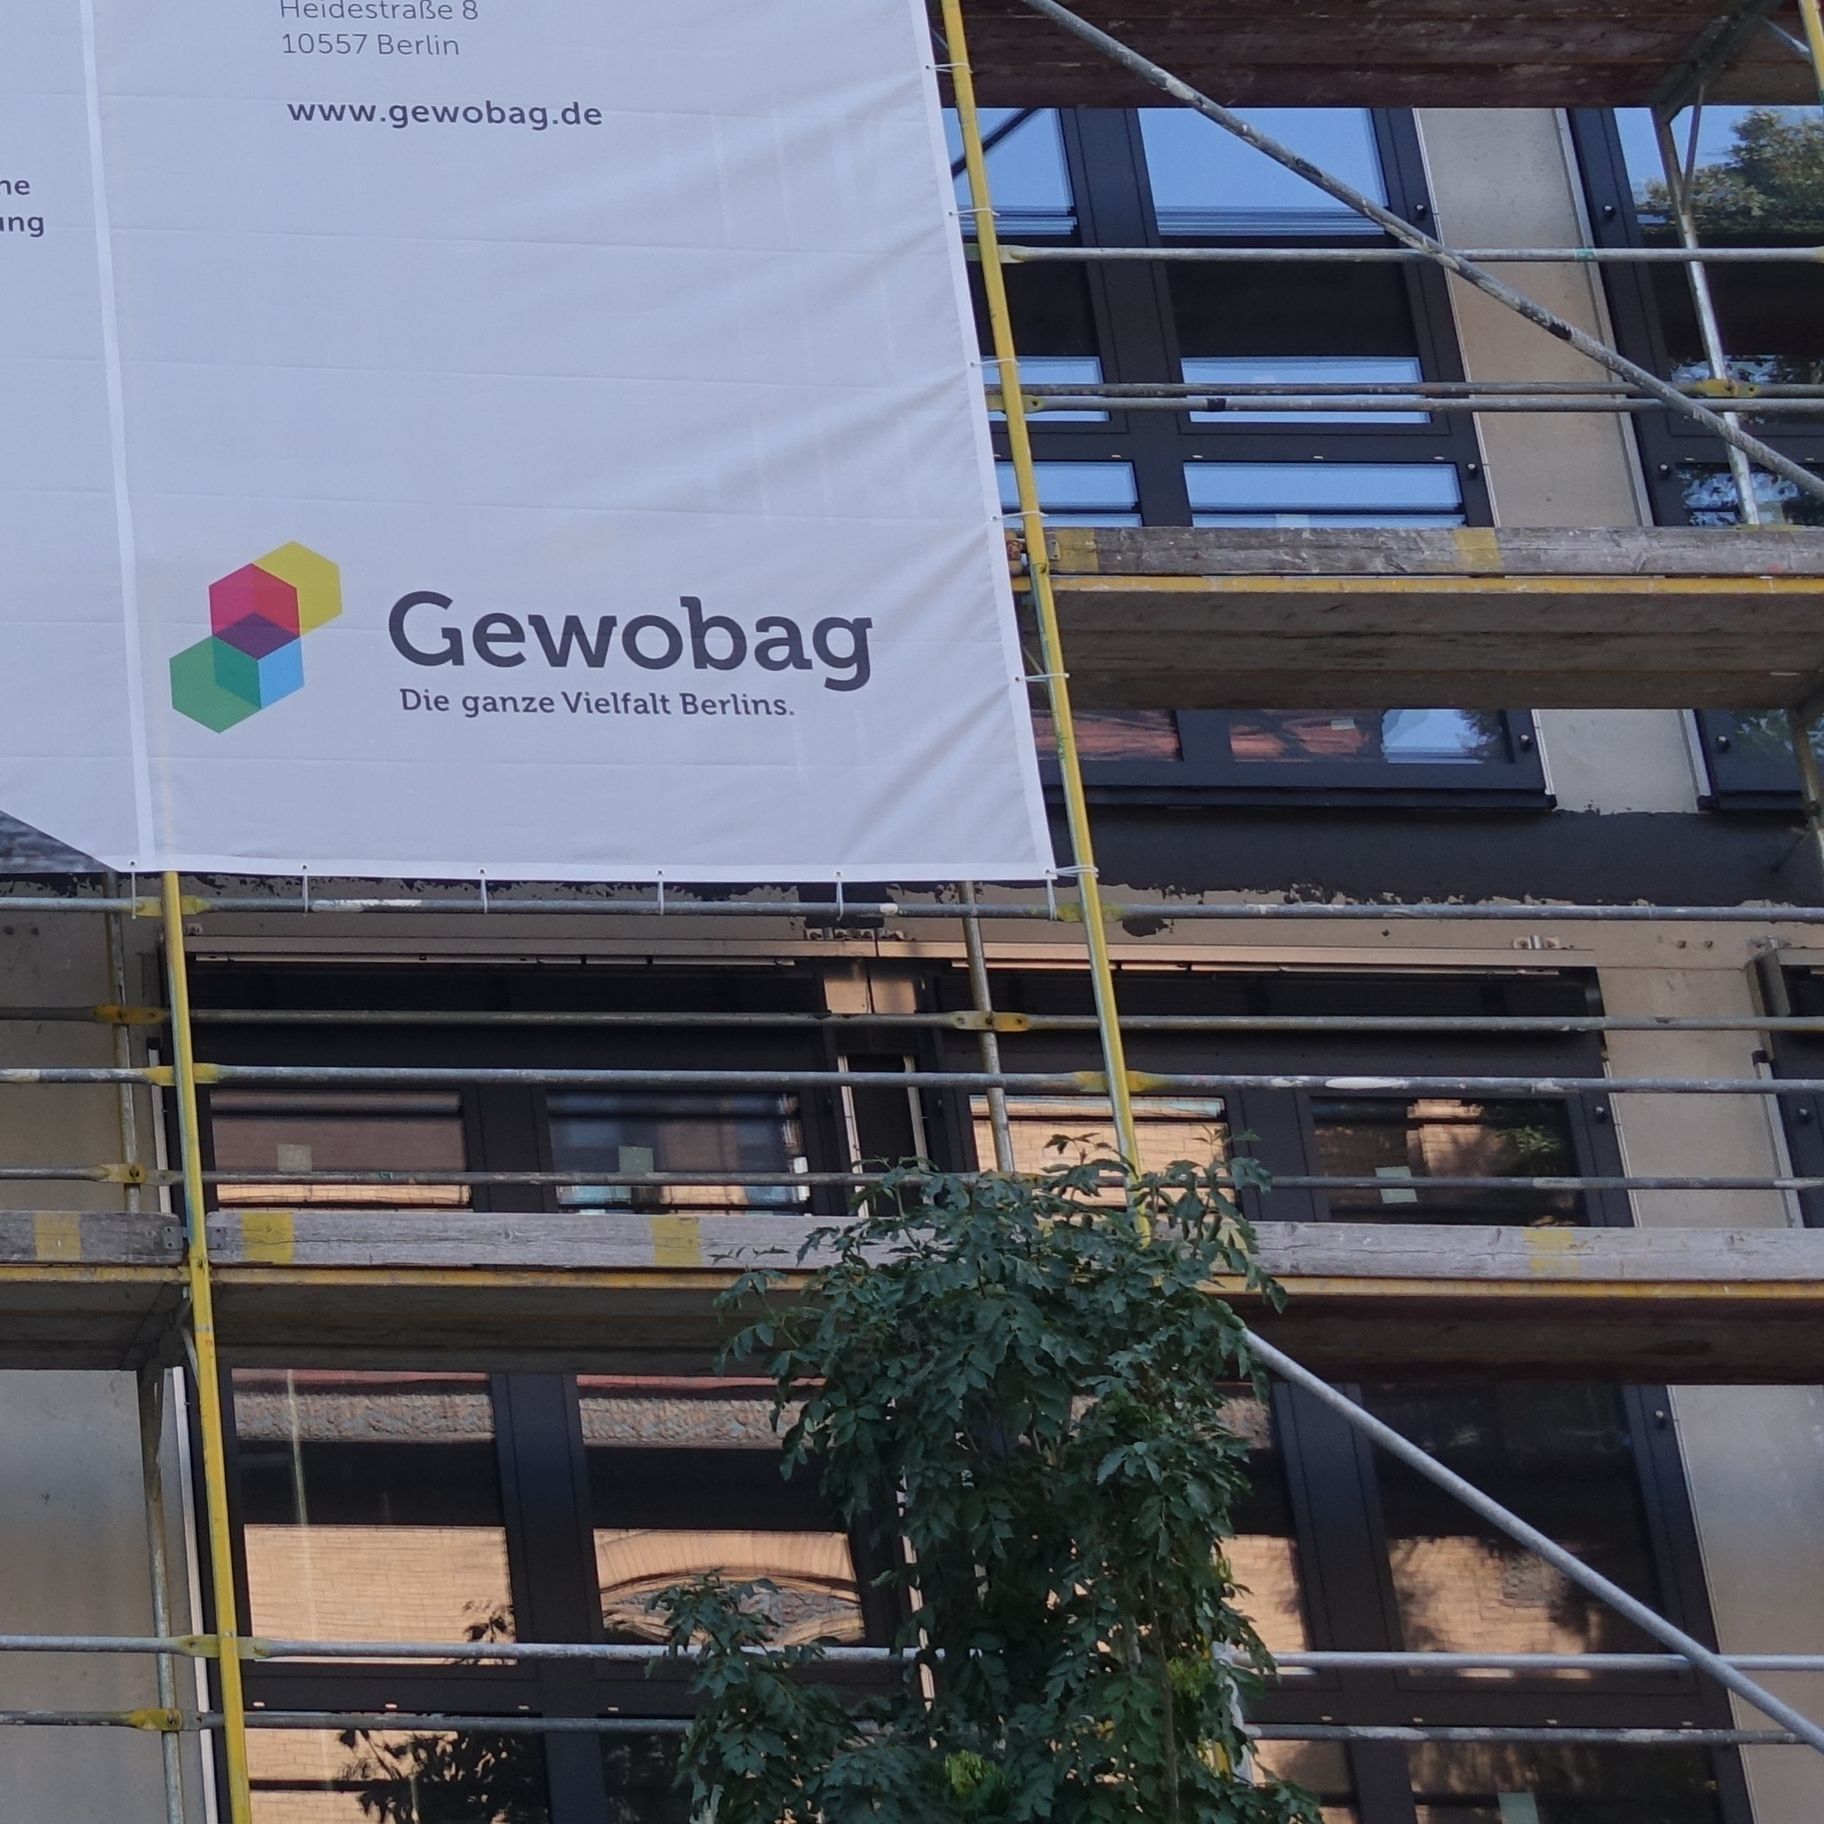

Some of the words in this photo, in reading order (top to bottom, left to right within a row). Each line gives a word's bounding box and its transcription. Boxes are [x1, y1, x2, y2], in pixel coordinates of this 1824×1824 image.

[462, 0, 479, 21] 8
[282, 32, 368, 55] 10557
[377, 33, 460, 56] Berlin
[286, 99, 603, 131] www.gewobag.de
[388, 590, 874, 692] Gewobag
[399, 688, 450, 712] Die
[461, 695, 555, 719] ganze
[560, 691, 672, 715] Vielfalt
[678, 692, 795, 716] Berlins.
